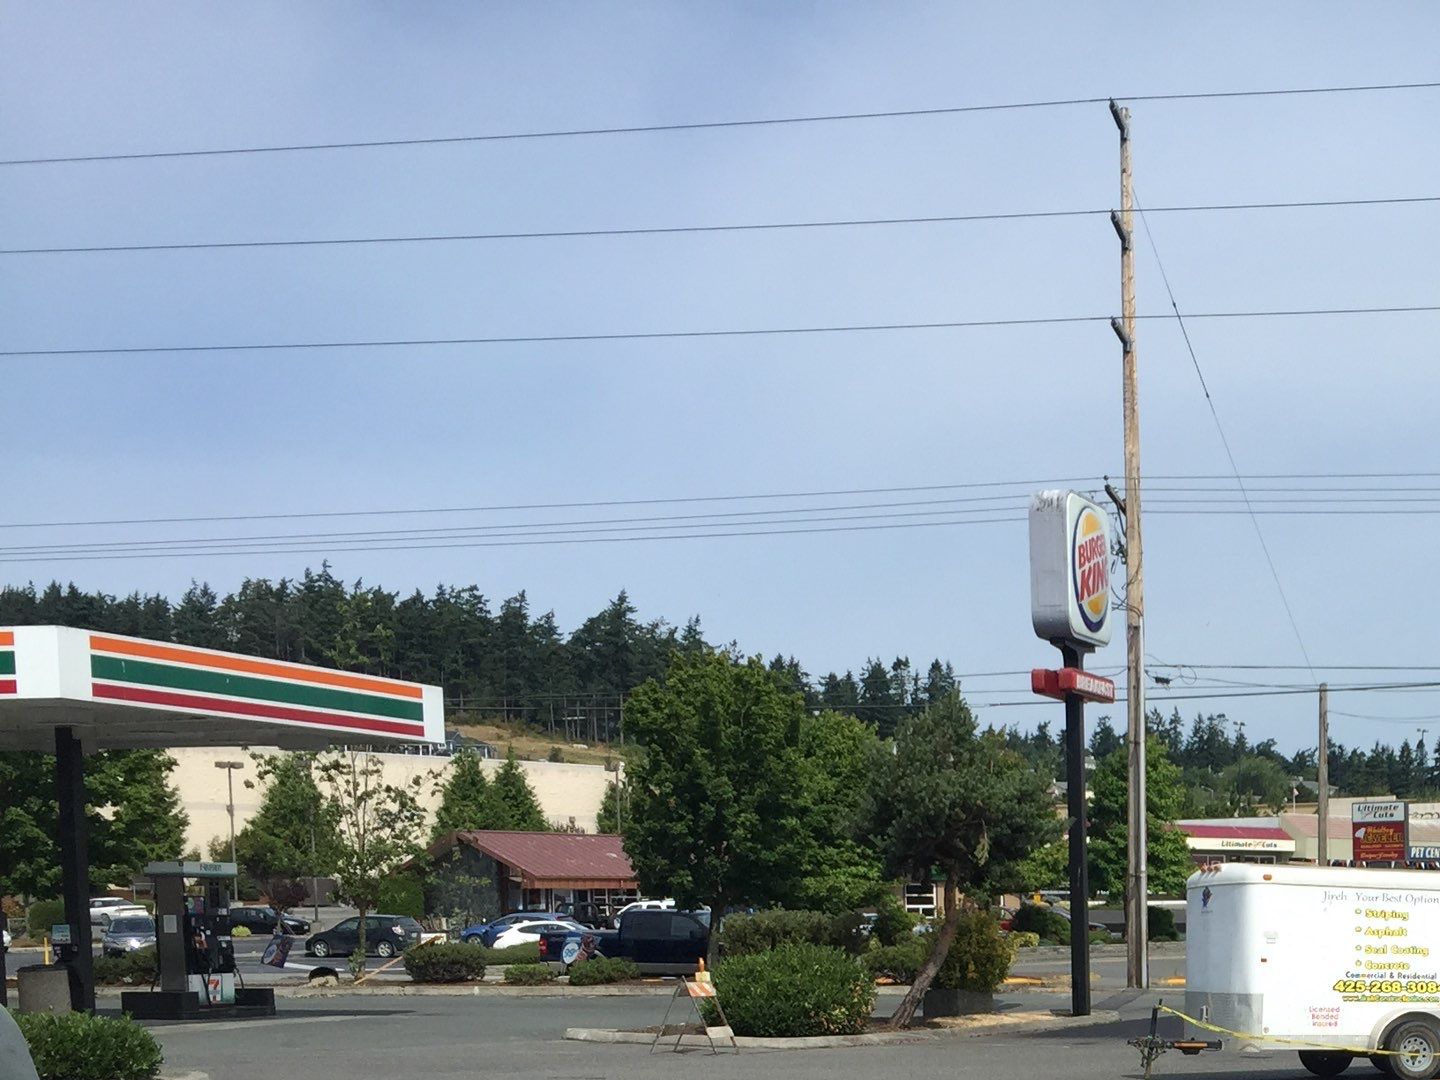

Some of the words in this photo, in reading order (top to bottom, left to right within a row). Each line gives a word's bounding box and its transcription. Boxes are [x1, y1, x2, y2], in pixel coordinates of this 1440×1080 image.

[1357, 803, 1399, 812] Ultimate
[1373, 811, 1394, 819] Cuts
[1410, 847, 1425, 858] PET
[1322, 890, 1347, 903] Jireh
[1355, 892, 1379, 902] Your
[1382, 892, 1402, 902] Best
[1405, 893, 1439, 906] Option
[1364, 908, 1409, 921] Striping
[1364, 926, 1407, 939] Asphalt
[1364, 945, 1387, 954] Seal
[1391, 945, 1429, 957] Coating
[1364, 960, 1410, 970] Concrete
[1345, 971, 1387, 979] Commercial
[1389, 971, 1395, 979] &
[1397, 971, 1438, 980] Residential
[1308, 1005, 1341, 1013] Licensed
